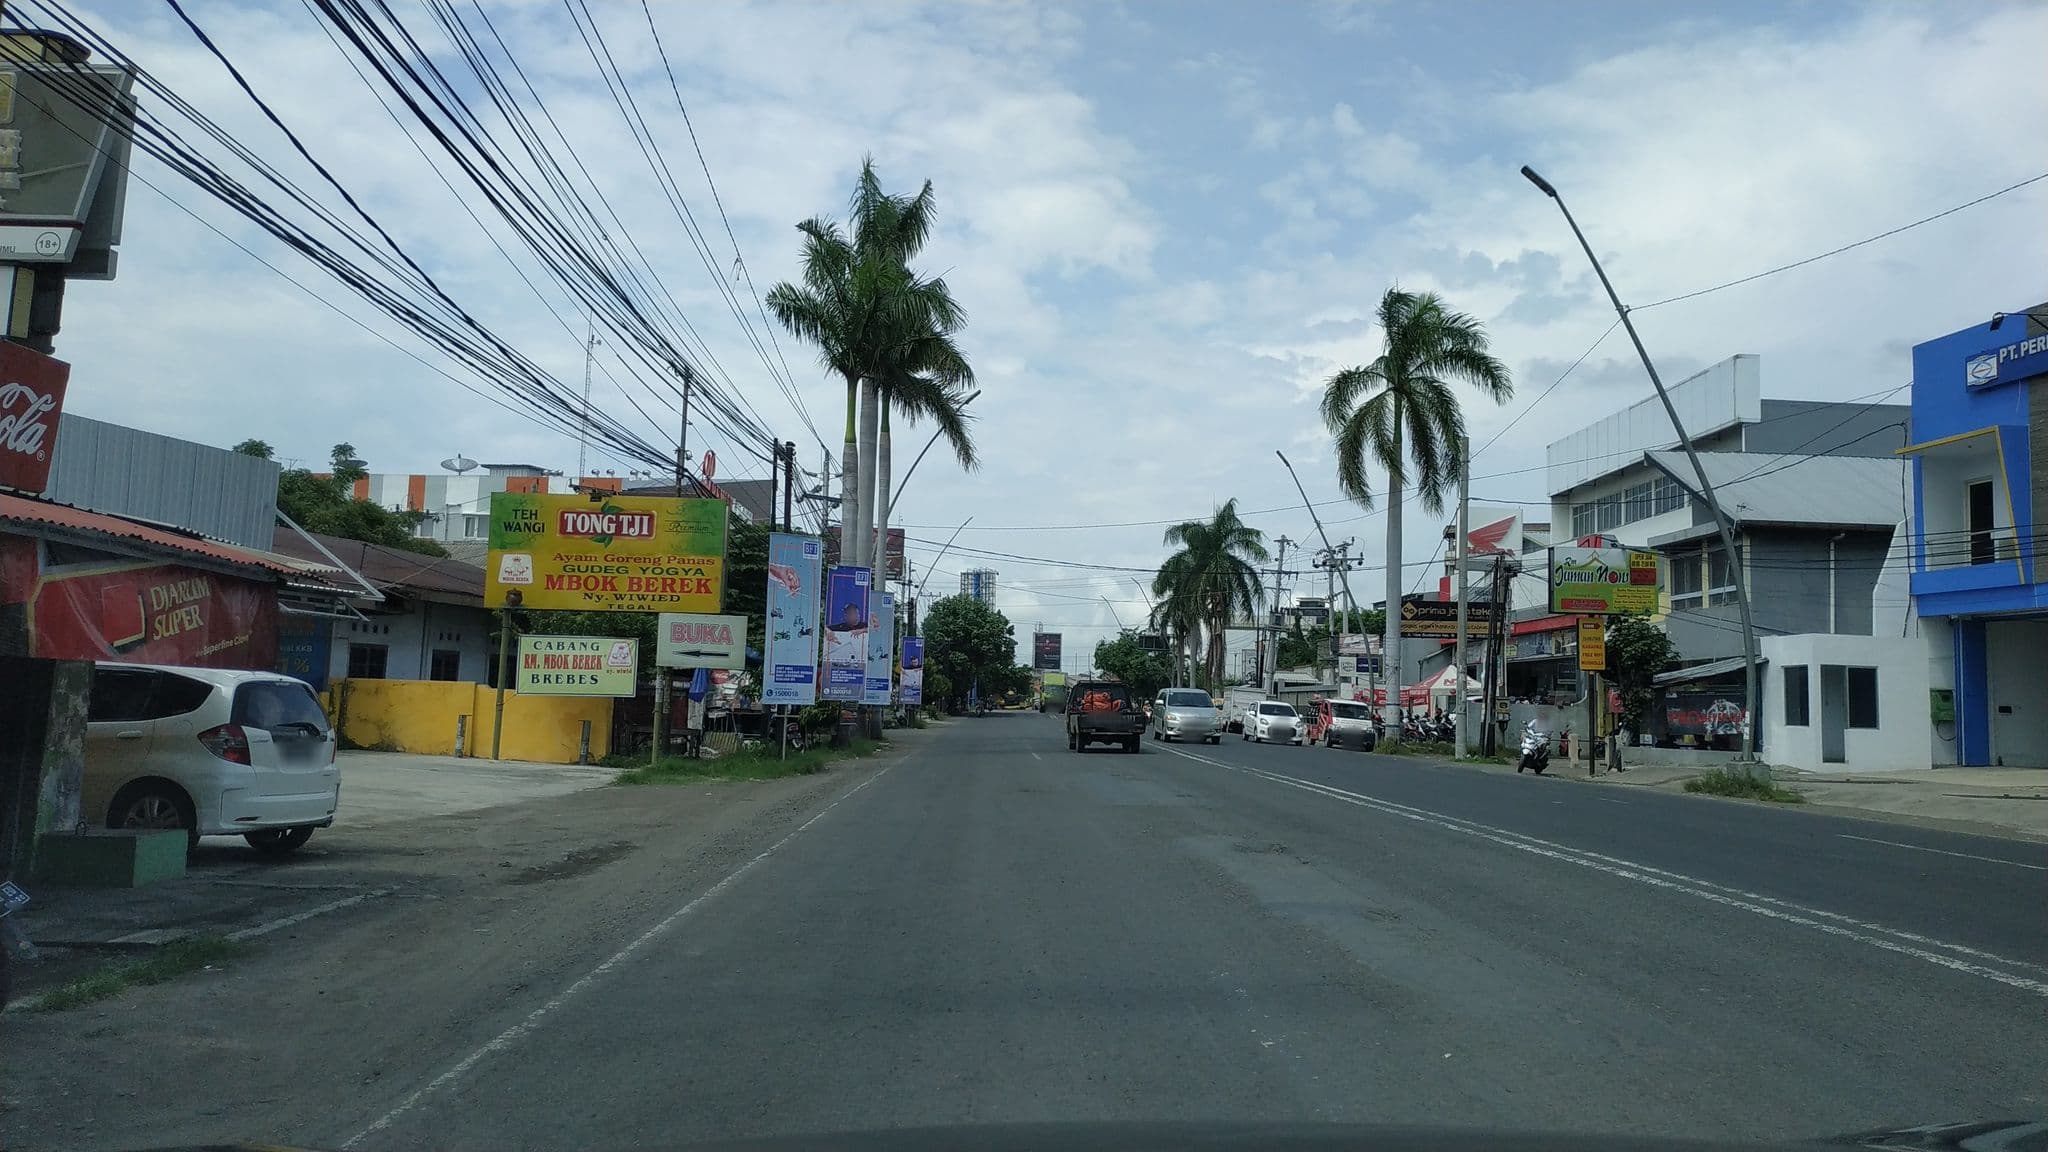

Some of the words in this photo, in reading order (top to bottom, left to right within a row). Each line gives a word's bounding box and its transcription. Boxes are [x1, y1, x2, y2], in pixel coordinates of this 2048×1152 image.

[39, 239, 58, 249] 18+
[1999, 344, 2019, 364] PT.
[2020, 334, 2048, 358] PER
[512, 509, 538, 520] TEH
[503, 521, 545, 533] WANGI
[564, 513, 616, 535] TONG
[619, 514, 649, 536] TJI
[805, 543, 817, 554] BFI
[553, 552, 598, 564] Ayam
[604, 553, 662, 567] Goreng
[666, 555, 715, 566] Panas
[563, 564, 629, 575] GUDEG
[639, 566, 705, 577] YOGYA
[1597, 565, 1629, 584] Now
[544, 573, 618, 592] MBOK
[627, 576, 713, 595] BEREK
[150, 576, 211, 612] DJARUM
[583, 592, 609, 604] Ny.
[614, 593, 681, 603] WIWIED
[607, 603, 655, 611] TEGAL
[1418, 606, 1446, 616] prima
[152, 605, 204, 641] SUPER
[670, 622, 734, 645] BUKA
[533, 641, 600, 651] CABANG
[524, 653, 540, 669] RM.
[543, 654, 570, 669] MBOK
[572, 654, 603, 670] BEREK
[531, 673, 599, 685] BREBES
